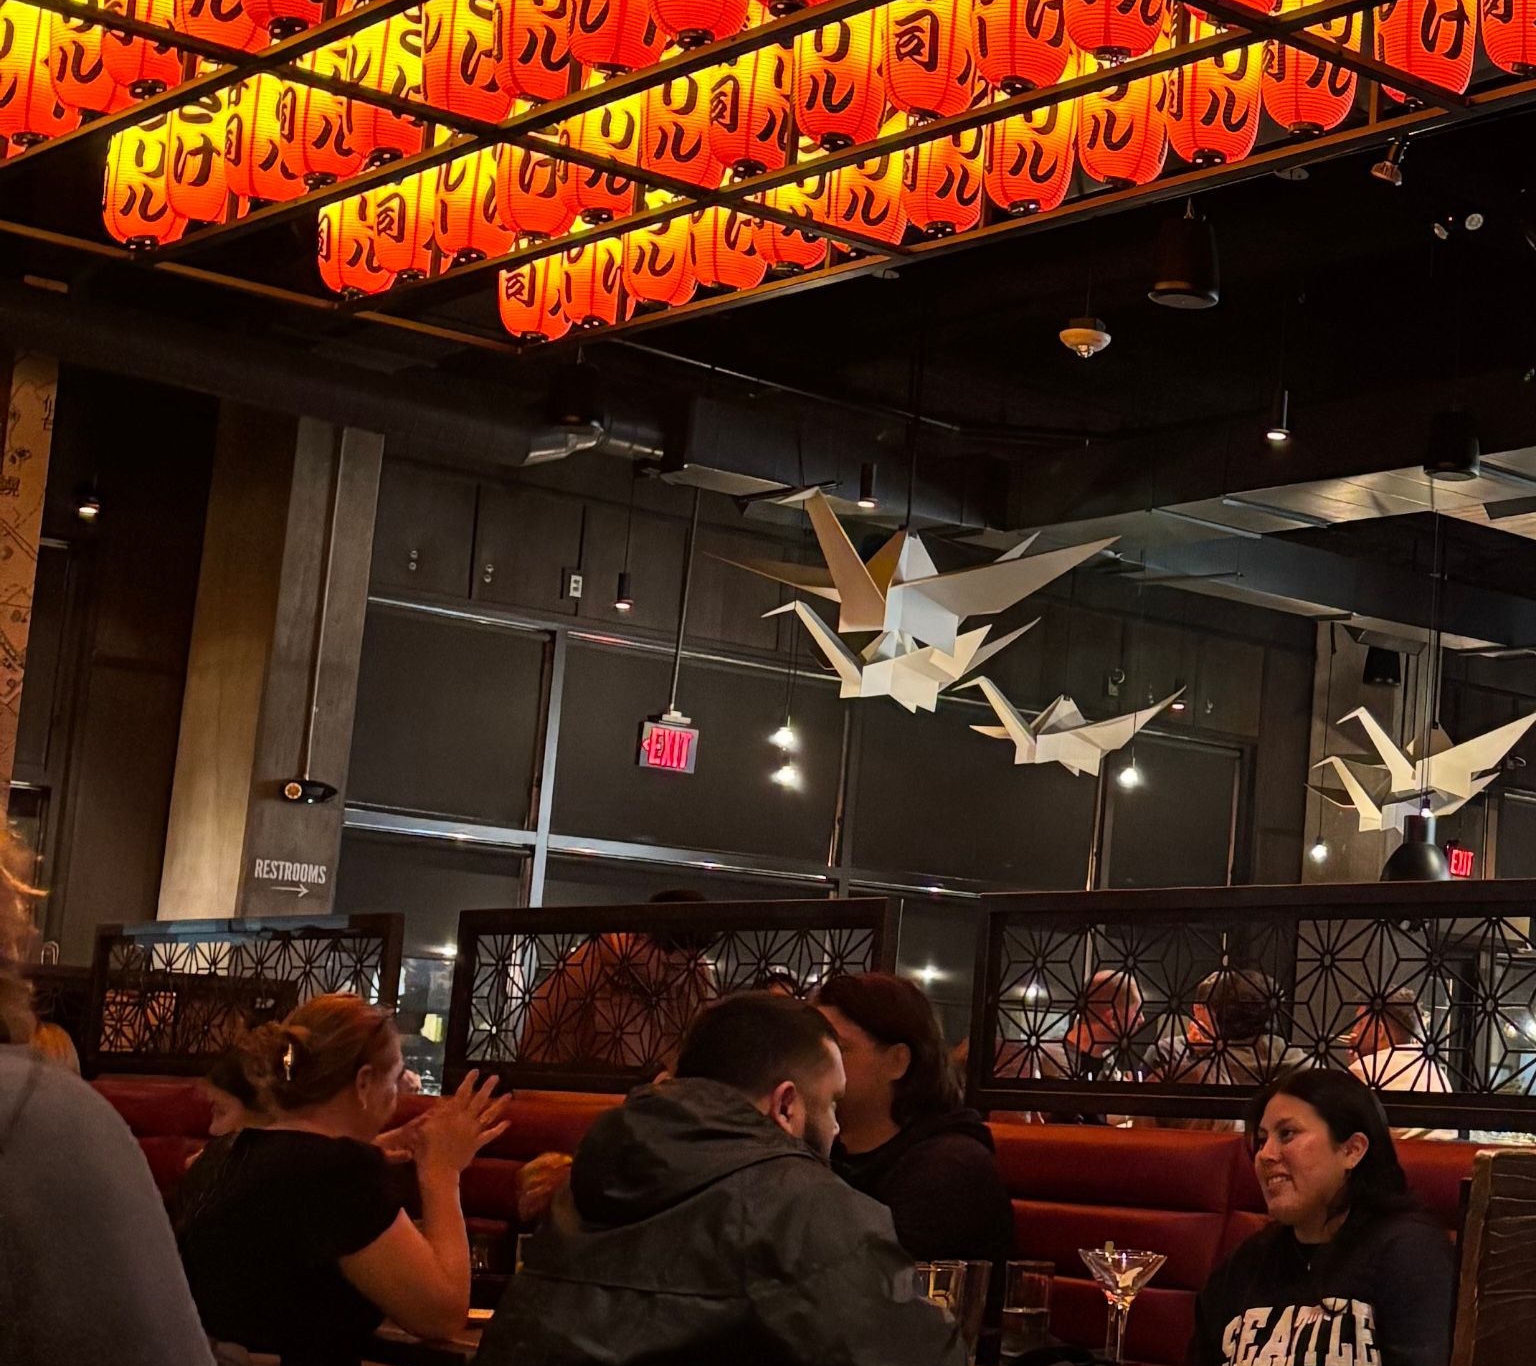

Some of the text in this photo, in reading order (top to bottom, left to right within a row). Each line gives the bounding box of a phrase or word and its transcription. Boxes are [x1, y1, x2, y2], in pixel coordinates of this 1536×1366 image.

[806, 20, 855, 113] リル
[895, 7, 940, 72] 司
[654, 75, 701, 163] リル
[711, 74, 740, 132] 司
[1200, 45, 1249, 132] リル
[120, 116, 169, 222] リル
[935, 127, 982, 206] リル
[1008, 104, 1057, 182] リル
[376, 192, 406, 243] 司
[506, 263, 535, 307] 司
[648, 726, 694, 769] EXIT
[254, 858, 327, 884] RESTROOMS
[1451, 849, 1474, 876] EXIT
